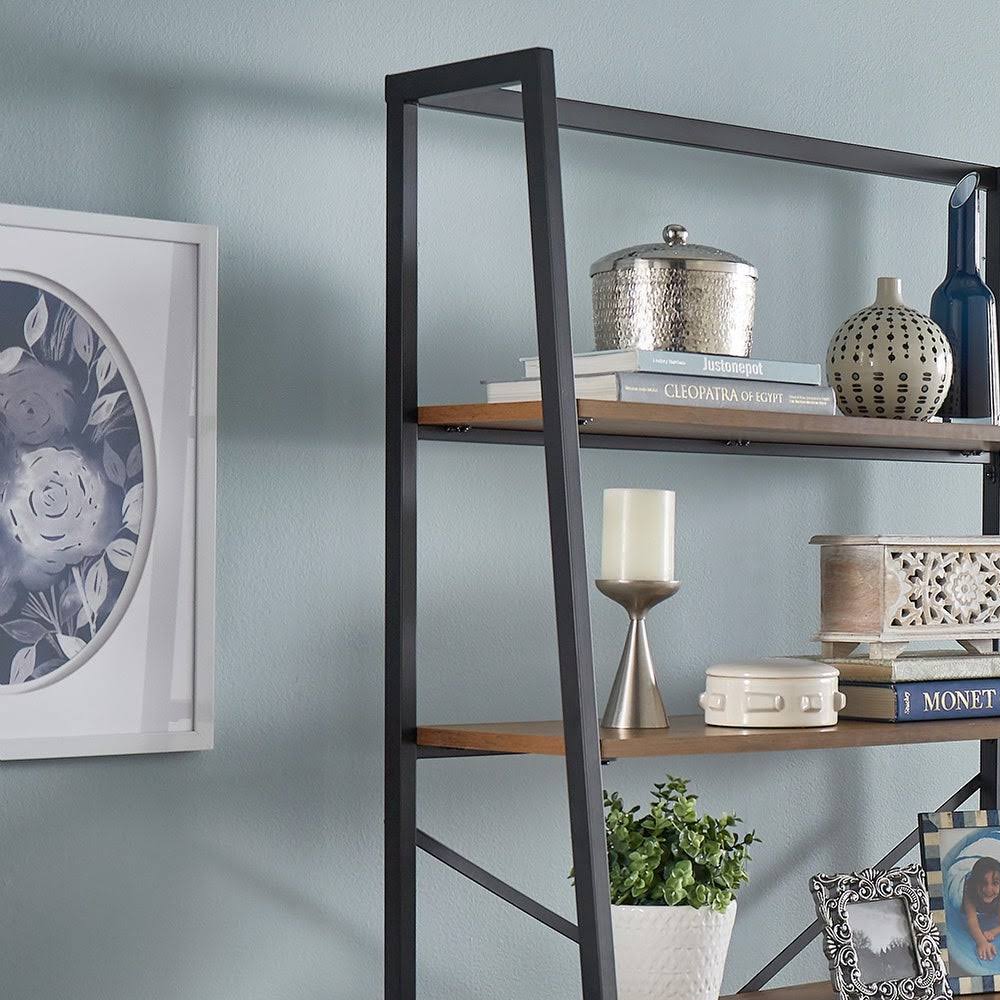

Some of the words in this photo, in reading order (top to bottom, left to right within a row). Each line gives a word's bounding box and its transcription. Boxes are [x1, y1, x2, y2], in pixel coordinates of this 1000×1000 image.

[703, 357, 763, 377] Justonepot
[664, 384, 738, 402] CLEOPATRA
[741, 391, 753, 402] OF
[756, 392, 783, 403] EGYPT
[922, 689, 997, 712] MONET
